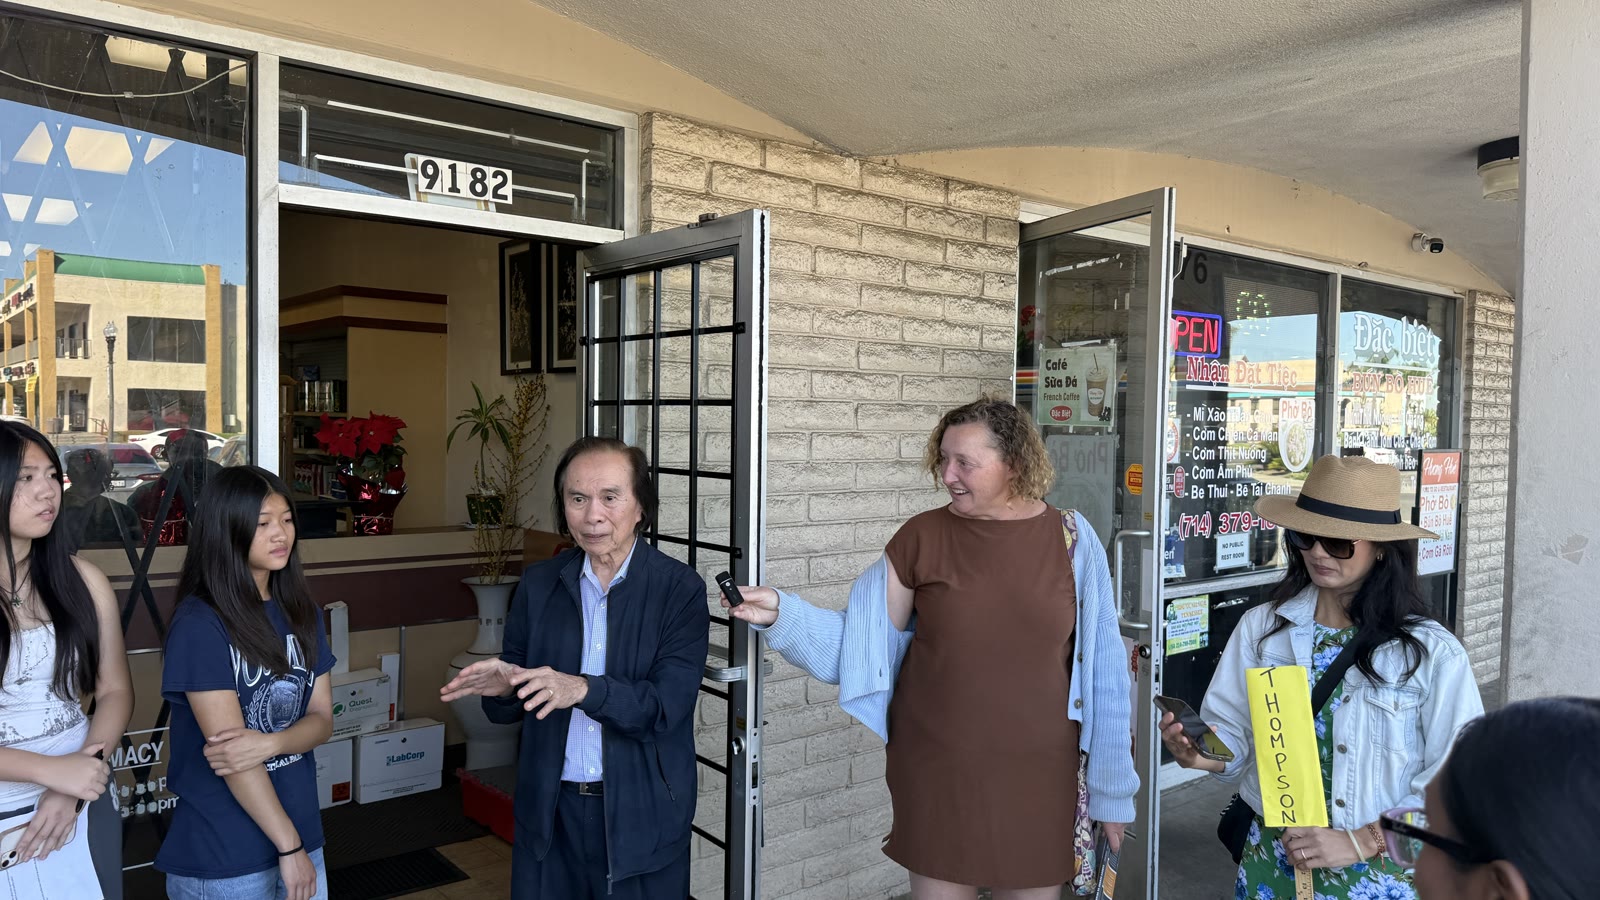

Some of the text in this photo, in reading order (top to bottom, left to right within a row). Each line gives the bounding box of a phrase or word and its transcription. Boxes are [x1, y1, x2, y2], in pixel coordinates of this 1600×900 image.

[420, 159, 508, 201] 9182
[1172, 316, 1219, 353] PEN
[1354, 313, 1434, 361] Đặc biệt
[1045, 358, 1068, 371] Café
[1186, 356, 1230, 387] Nhận
[1267, 363, 1297, 391] Tiệc
[1065, 375, 1078, 388] Đá
[1352, 369, 1384, 393] BÚN
[1385, 371, 1404, 394] BÒ
[1043, 393, 1062, 401] French
[1063, 393, 1080, 401] Coffee
[1193, 403, 1206, 422] Mì
[1207, 406, 1226, 421] Xào
[1282, 400, 1299, 419] Phở
[1301, 401, 1312, 418] Bò
[1218, 446, 1238, 462] Thịt
[1238, 444, 1267, 462] Nướng
[1207, 484, 1228, 498] Thui
[1250, 481, 1263, 496] Tái
[1265, 482, 1291, 495] Chanh
[1420, 494, 1449, 512] Phở Bò
[1179, 511, 1212, 541] (714)
[1229, 540, 1244, 548] PUBLIC
[1232, 551, 1245, 559] ROOM
[349, 697, 372, 708] Quest
[109, 741, 164, 767] MACY
[1260, 666, 1297, 824] THOMPSON
[391, 751, 425, 763] LabCorp
